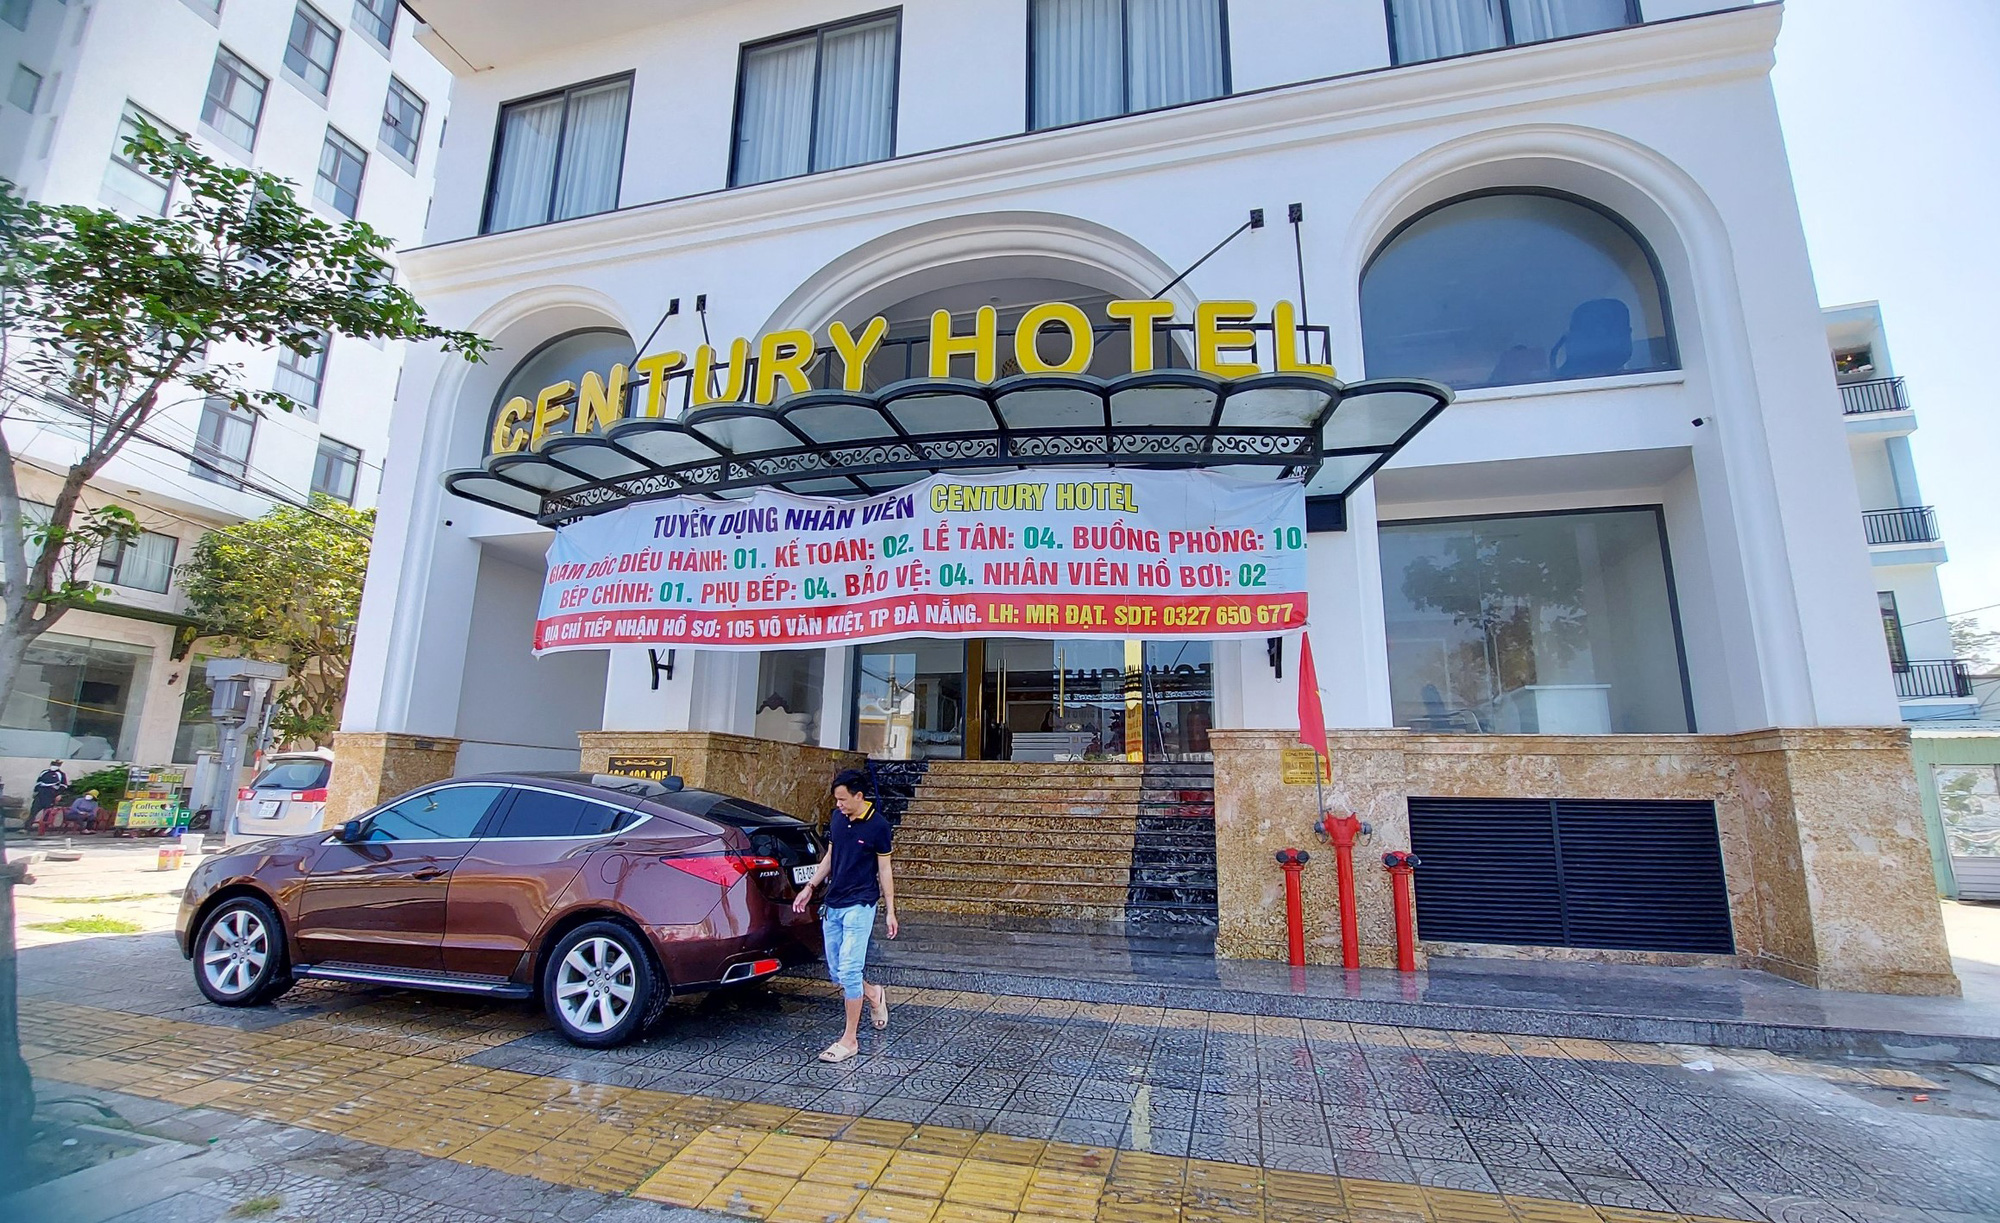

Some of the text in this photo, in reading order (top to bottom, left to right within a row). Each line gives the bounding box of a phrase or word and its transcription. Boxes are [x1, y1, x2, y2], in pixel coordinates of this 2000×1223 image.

[493, 299, 1338, 454] CENTURY HOTEL
[654, 482, 1138, 539] TUYỂN DỤNG NHÂN VIÊN CENTURY HOTEL
[549, 561, 586, 584] GIÁM
[586, 553, 617, 579] ĐỐC
[618, 546, 663, 573] ĐIỀU
[668, 548, 727, 572] HÀNH:
[775, 537, 800, 567] KẾ
[806, 536, 875, 565] TOÁN:
[883, 533, 914, 558] 02.
[923, 519, 949, 551] LỄ
[957, 522, 1015, 550] TÂN:
[1023, 526, 1063, 549] 04.
[1073, 519, 1160, 553] BUỒNG
[1169, 526, 1264, 553] PHÒNG:
[559, 584, 588, 609] BẾP
[591, 579, 654, 605] CHÍNH:
[701, 582, 739, 607] PHỤ
[747, 573, 797, 602] BẾP:
[804, 577, 837, 600] 04.
[845, 565, 889, 597] BẢO
[896, 558, 931, 591] VỆ:
[939, 563, 974, 587] 04.
[983, 557, 1058, 586] NHÂN
[1067, 557, 1129, 586] VIÊN
[1138, 557, 1171, 587] HỒ
[1180, 563, 1231, 587] BƠI:
[1239, 563, 1267, 587] 02
[561, 616, 582, 639] CHỈ
[584, 614, 612, 638] TIẾP
[614, 616, 658, 639] NHẬN
[662, 614, 687, 636] HỒ
[691, 619, 721, 638] SƠ:
[726, 620, 754, 638] 105
[758, 616, 782, 637] VÕ
[785, 615, 823, 636] VĂN
[826, 611, 864, 636] KIỆT,
[869, 608, 890, 629] TP
[893, 601, 920, 625] ĐÀ
[926, 598, 982, 624] NẴNG.
[988, 604, 1019, 623] LH:
[1026, 604, 1059, 624] MR
[1065, 604, 1107, 629] ĐẠT.
[1114, 605, 1157, 626] SDT:
[1163, 605, 1211, 626] 0327
[1216, 605, 1250, 624] 650
[1257, 603, 1294, 623] 677
[135, 802, 159, 810] Coffee
